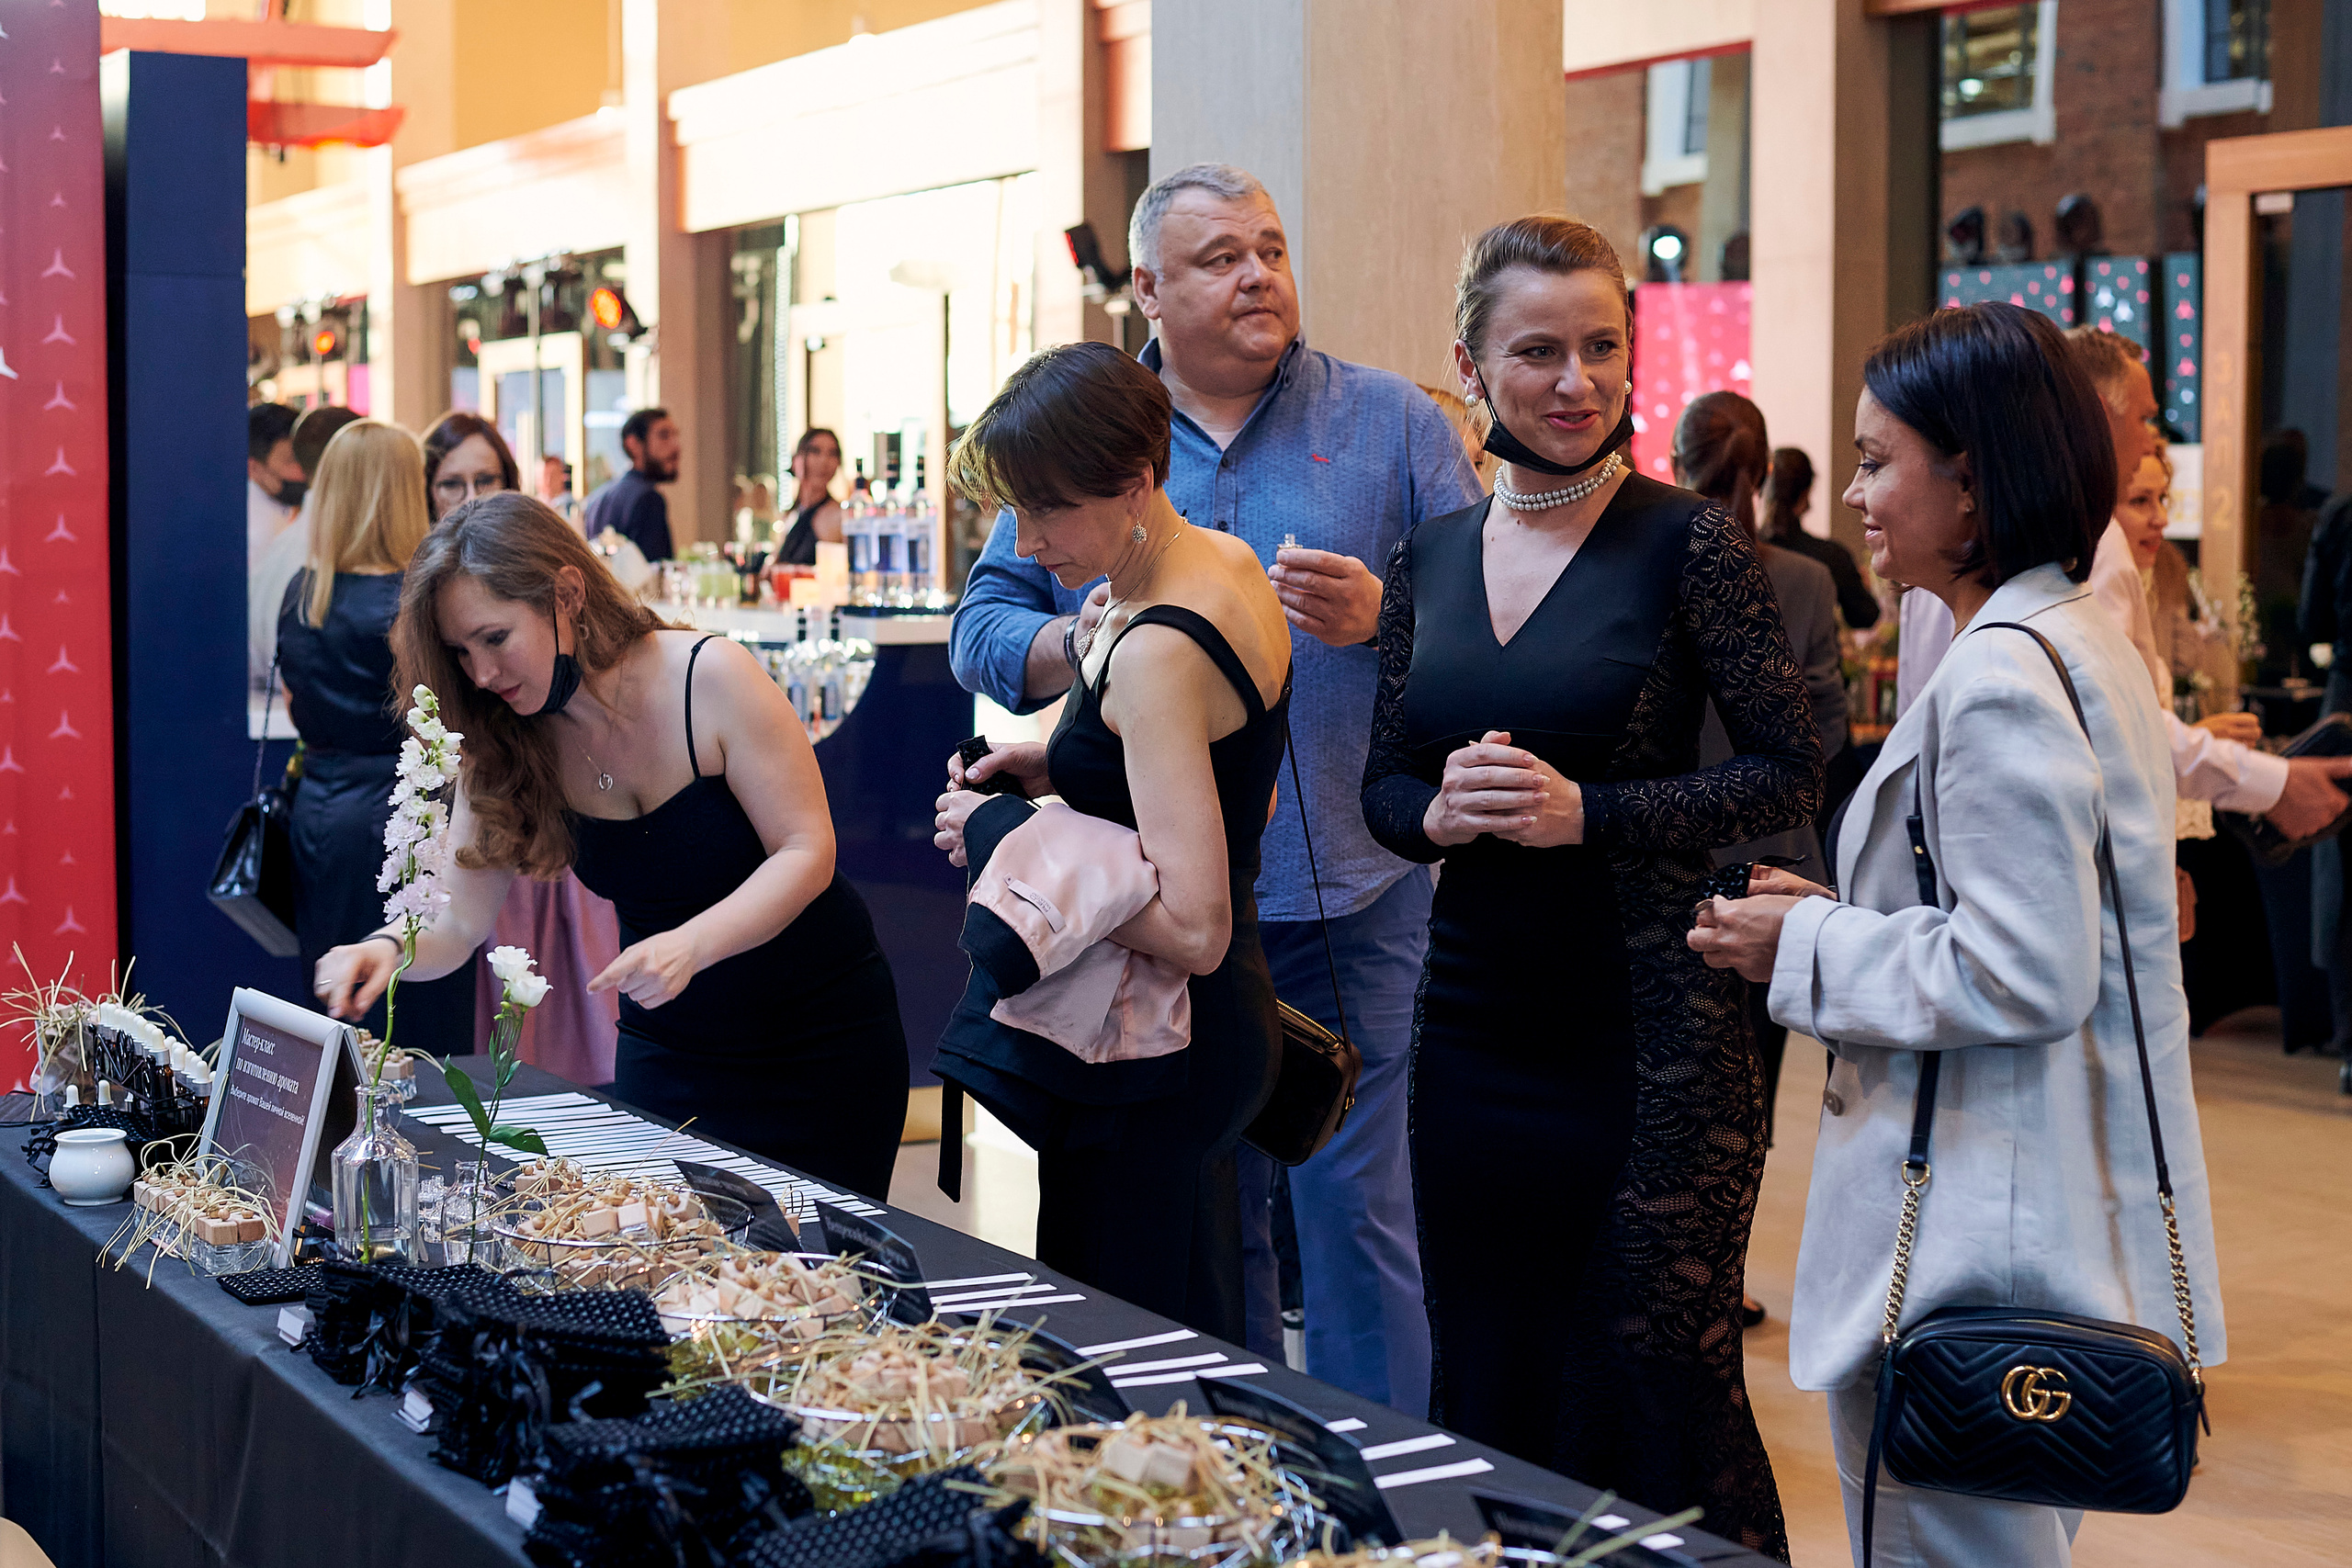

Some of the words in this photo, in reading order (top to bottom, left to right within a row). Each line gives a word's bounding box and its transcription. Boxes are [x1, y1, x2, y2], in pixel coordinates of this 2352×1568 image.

[241, 1027, 276, 1055] Мастер-класс
[235, 1057, 243, 1070] по
[243, 1060, 278, 1085] изготовлению
[277, 1074, 300, 1094] аромата
[230, 1084, 247, 1100] Выберите
[246, 1093, 260, 1105] аромат
[258, 1096, 272, 1111] Вашей
[270, 1104, 285, 1117] личной
